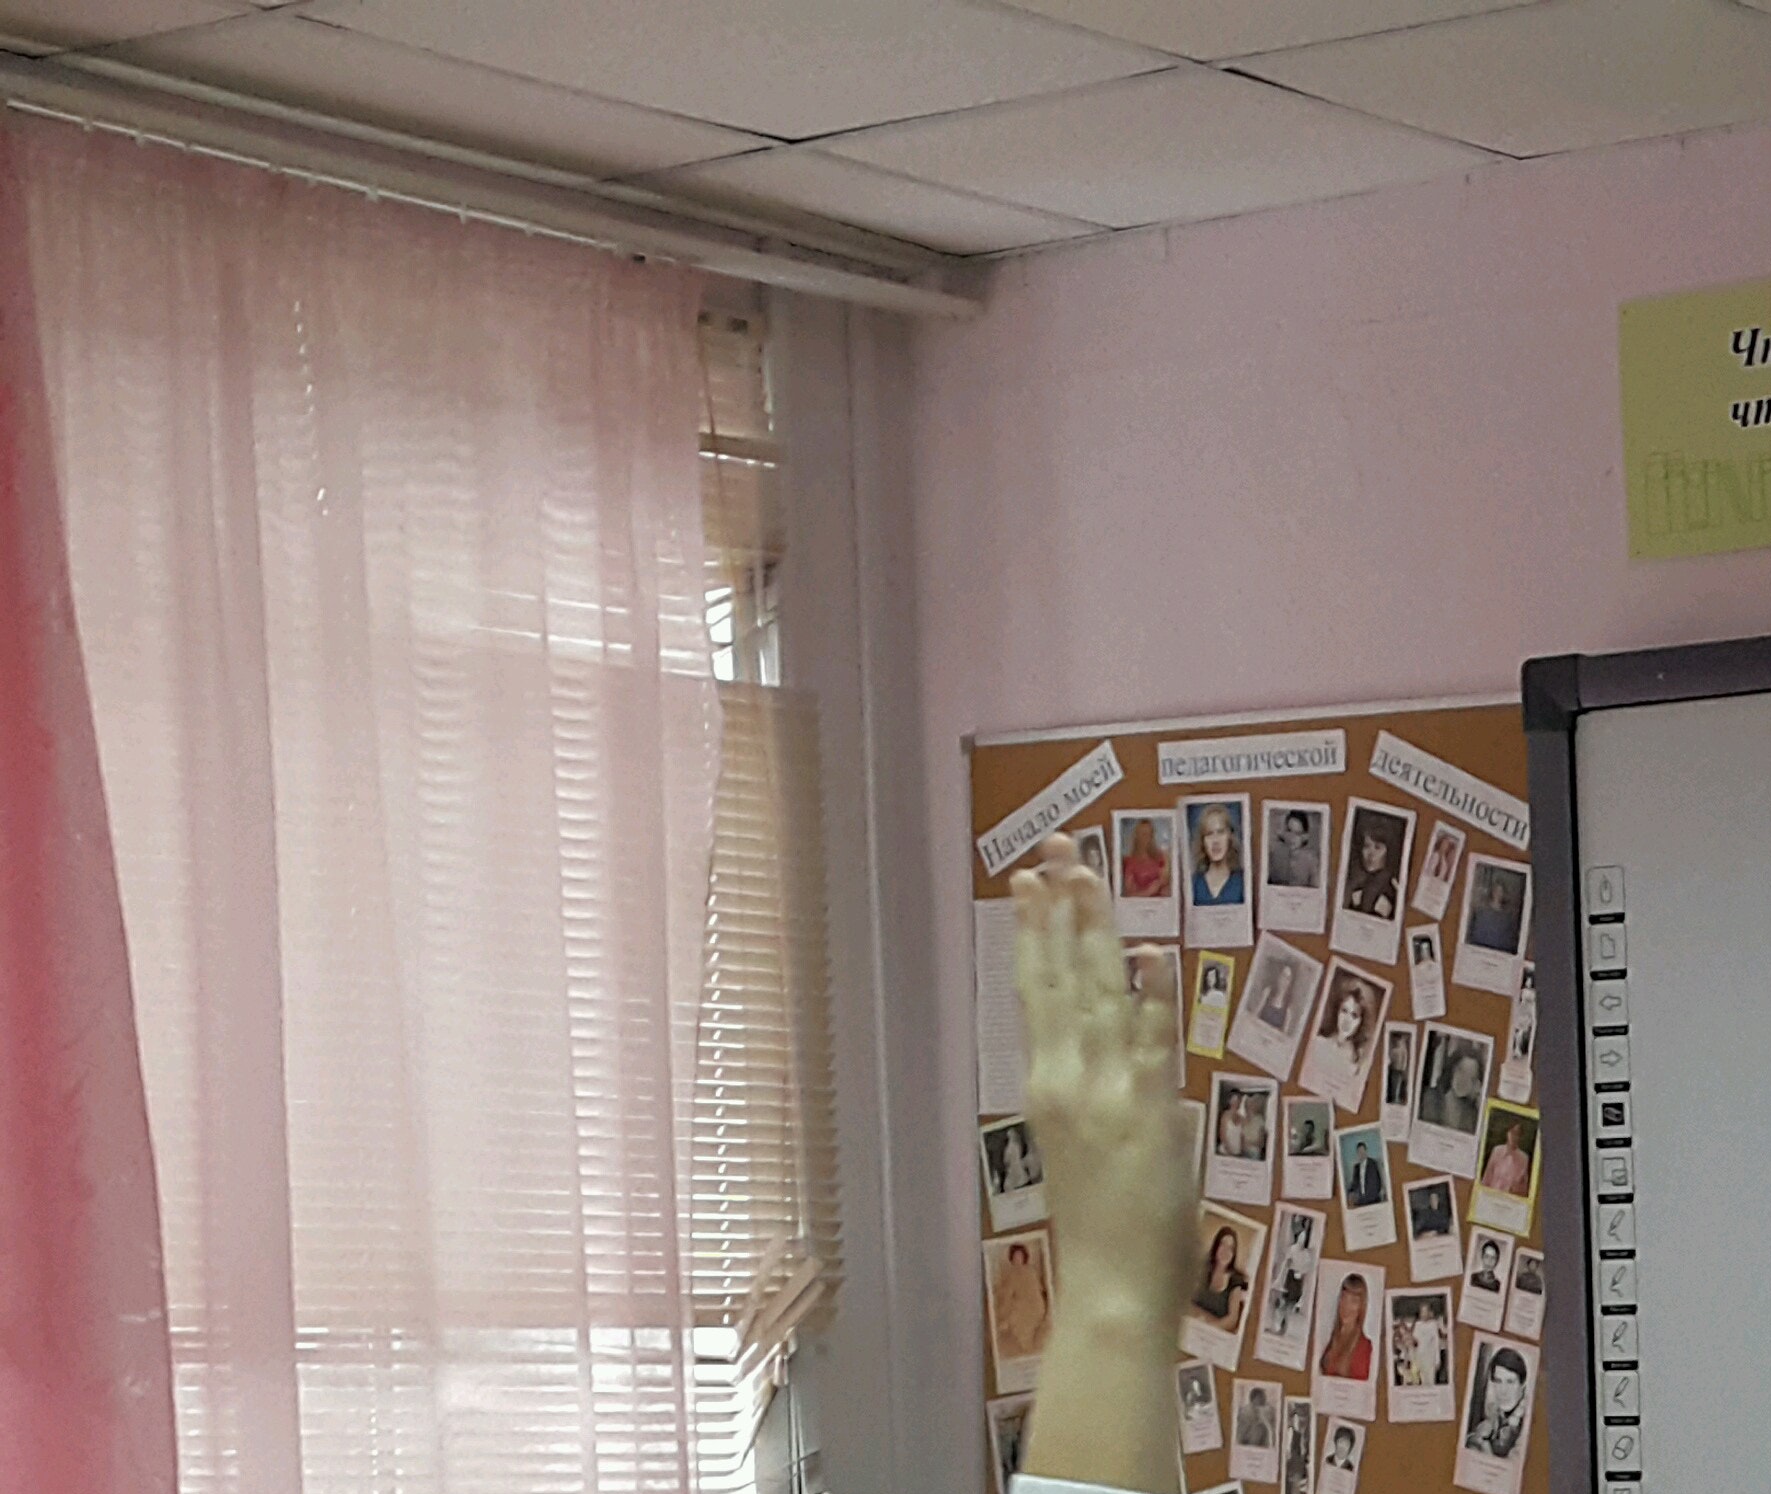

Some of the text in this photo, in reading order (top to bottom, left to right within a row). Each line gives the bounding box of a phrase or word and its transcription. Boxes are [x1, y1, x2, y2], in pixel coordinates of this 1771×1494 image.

[1161, 740, 1338, 778] педагогической
[1371, 750, 1528, 842] деятельности
[982, 754, 1116, 869] Начало моей
